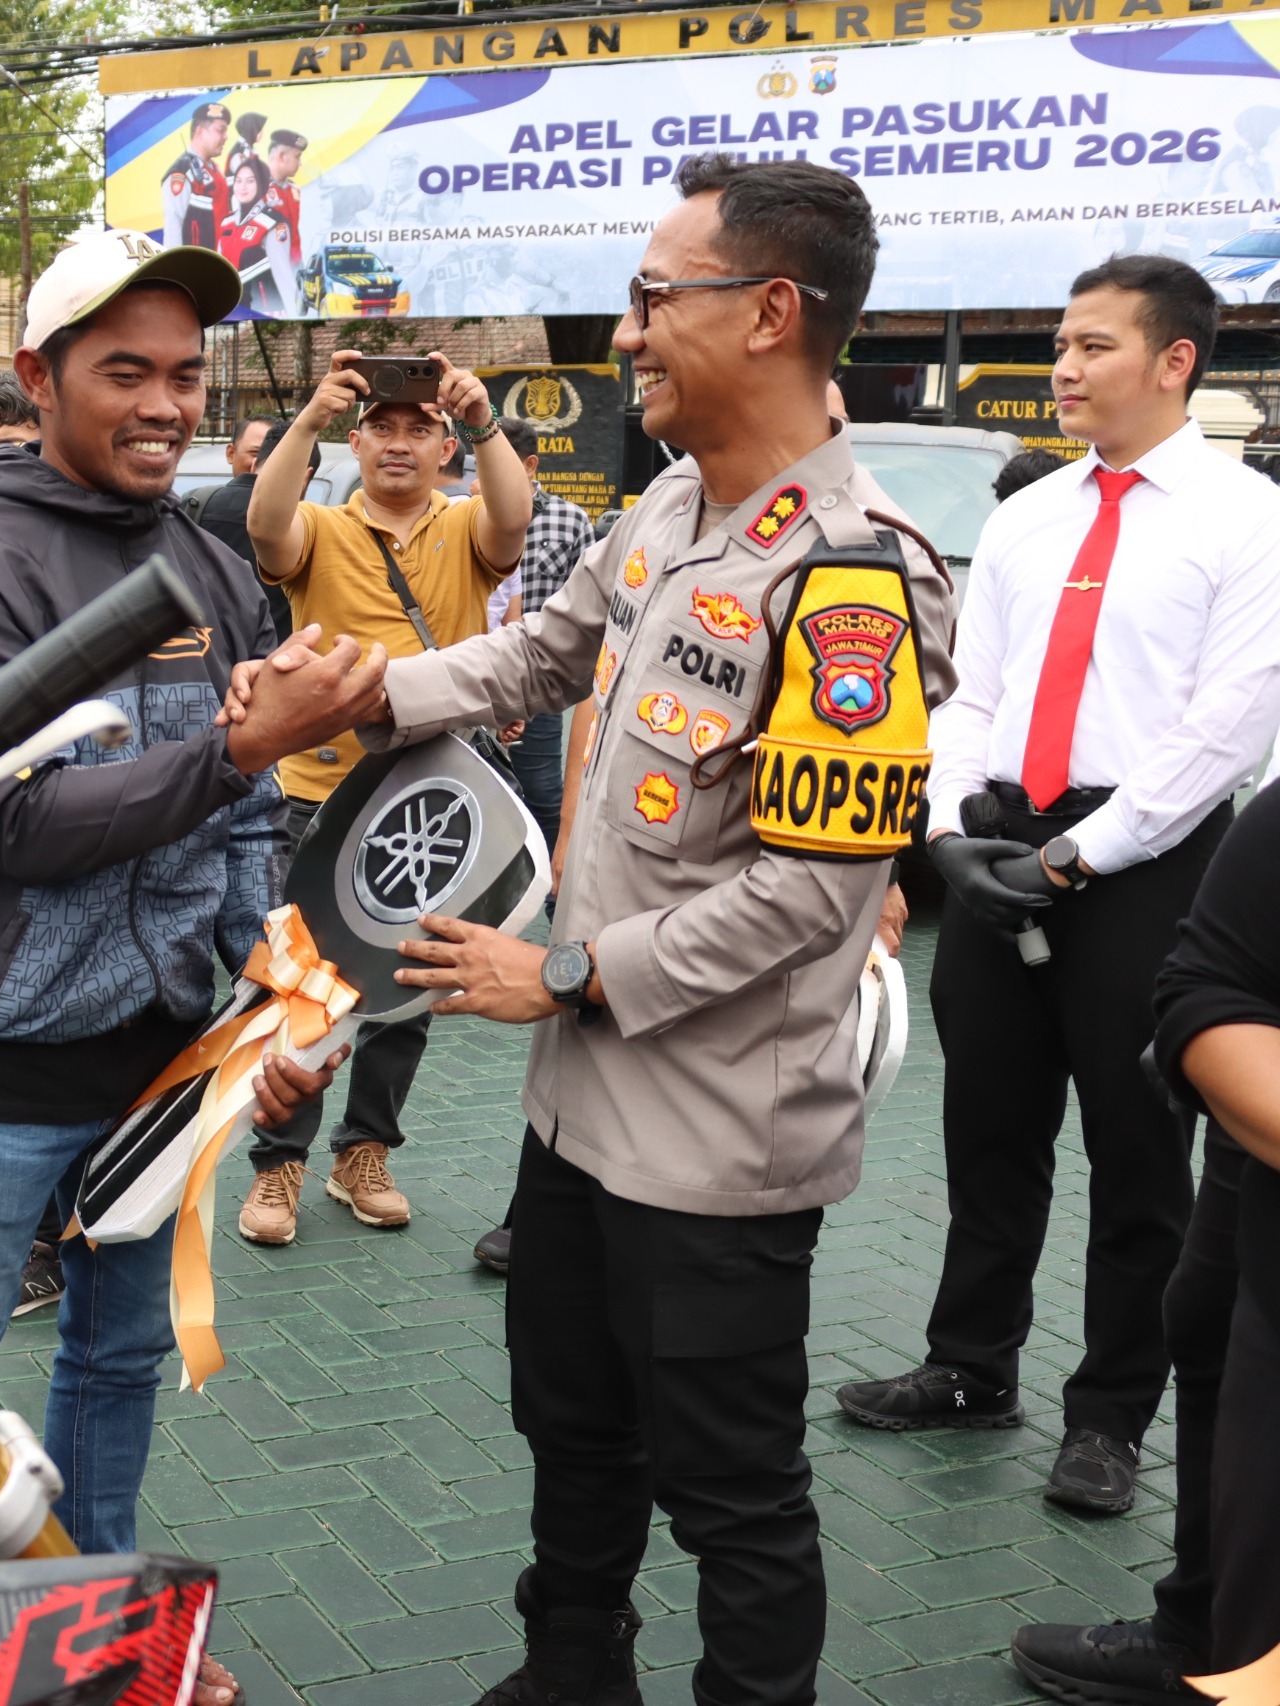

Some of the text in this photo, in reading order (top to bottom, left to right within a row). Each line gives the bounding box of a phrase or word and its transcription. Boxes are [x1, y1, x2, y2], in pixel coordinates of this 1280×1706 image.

[246, 22, 622, 78] LAPANGAN
[678, 0, 984, 49] POLRES
[508, 92, 1109, 154] APEL GELAR PASUKAN
[418, 156, 623, 195] OPERASI
[828, 136, 1052, 177] SEMERU
[1073, 127, 1222, 168] 2026
[330, 229, 383, 244] POLISI
[388, 226, 472, 242] BERSAMA
[477, 221, 598, 240] MASYARAKAT
[871, 212, 922, 227] YANG
[928, 209, 1005, 226] TERTIB,
[1010, 206, 1076, 223] AMAN
[1082, 204, 1129, 220] DAN
[976, 399, 1038, 419] CATUR
[817, 613, 896, 634] POLRES
[824, 621, 889, 639] MALANG
[661, 632, 747, 699] POLRI
[825, 640, 884, 657] JAWA TIMUR
